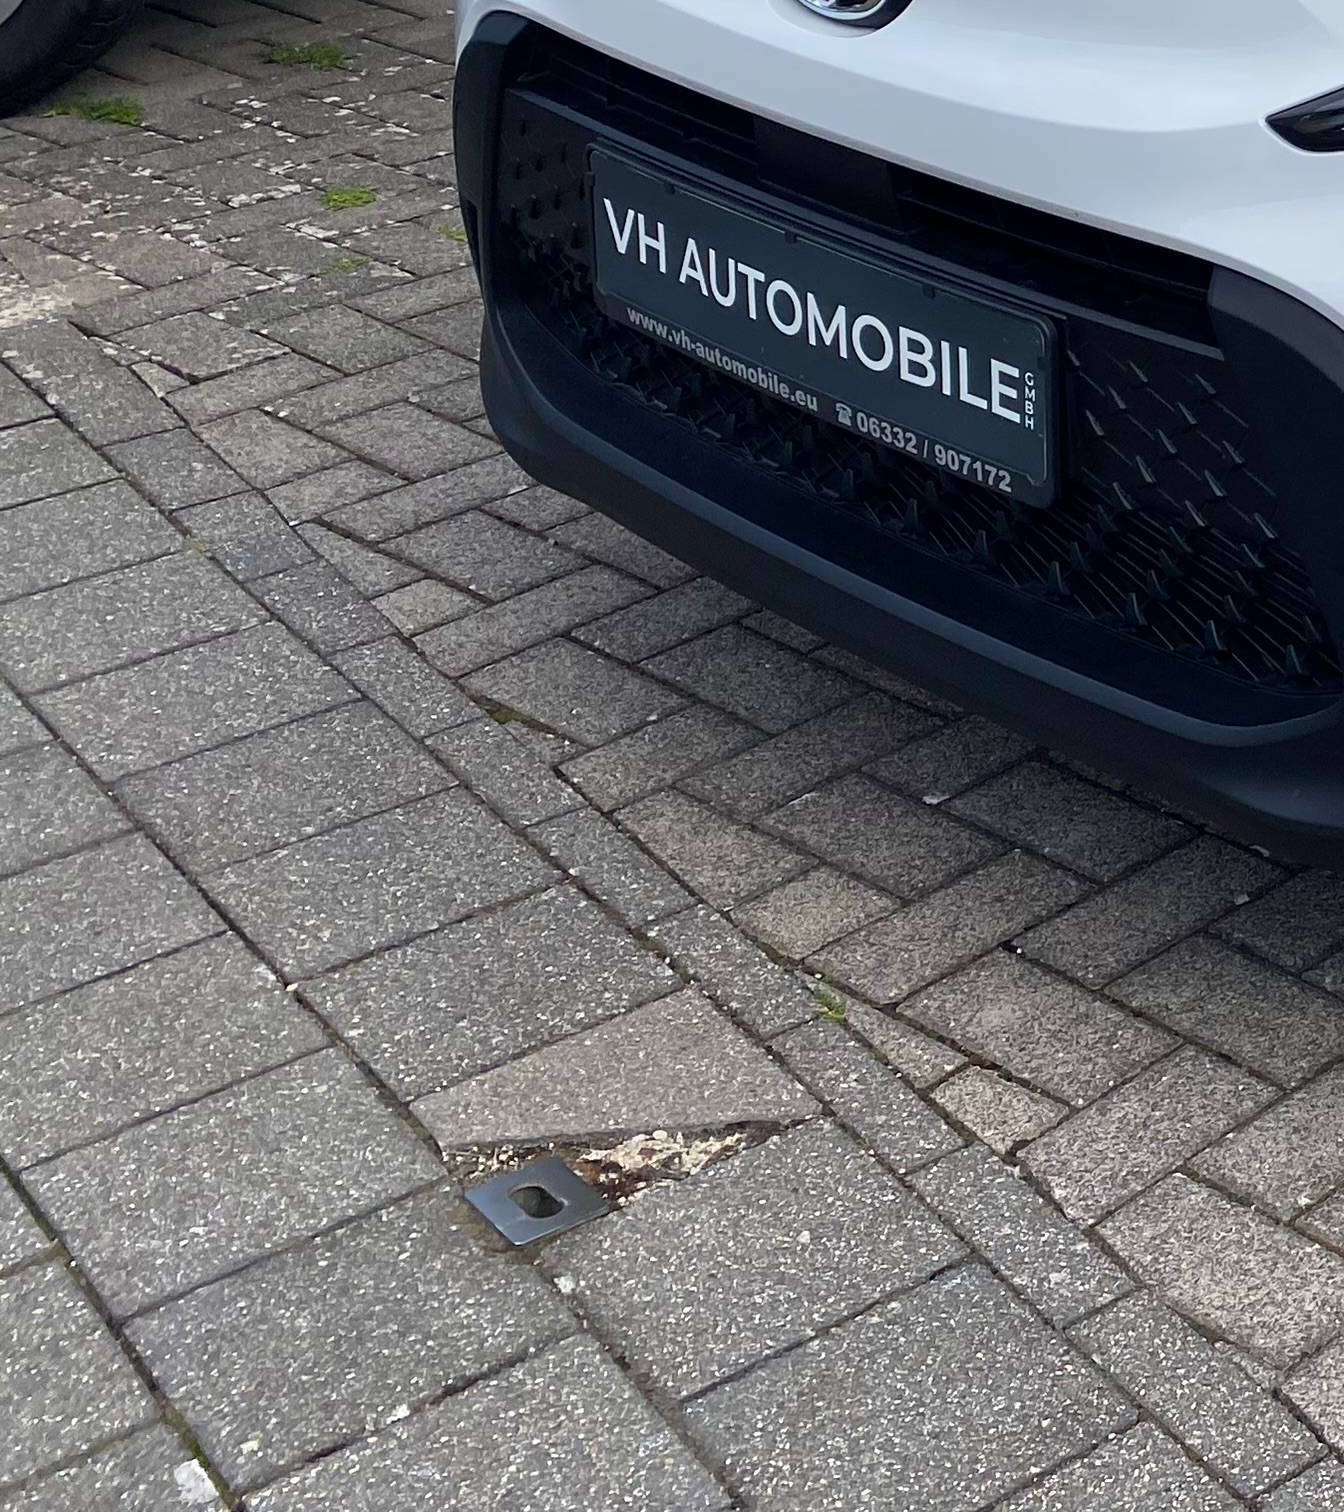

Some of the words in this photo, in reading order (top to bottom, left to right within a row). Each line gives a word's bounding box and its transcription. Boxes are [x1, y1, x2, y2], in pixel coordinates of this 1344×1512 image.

[602, 196, 667, 274] VH
[679, 237, 1022, 423] AUTOMOBILE
[626, 306, 819, 413] www.vh-automobile.eu
[856, 412, 919, 456] 06332
[933, 444, 1013, 494] 907172
[1024, 371, 1036, 431] GMBH
